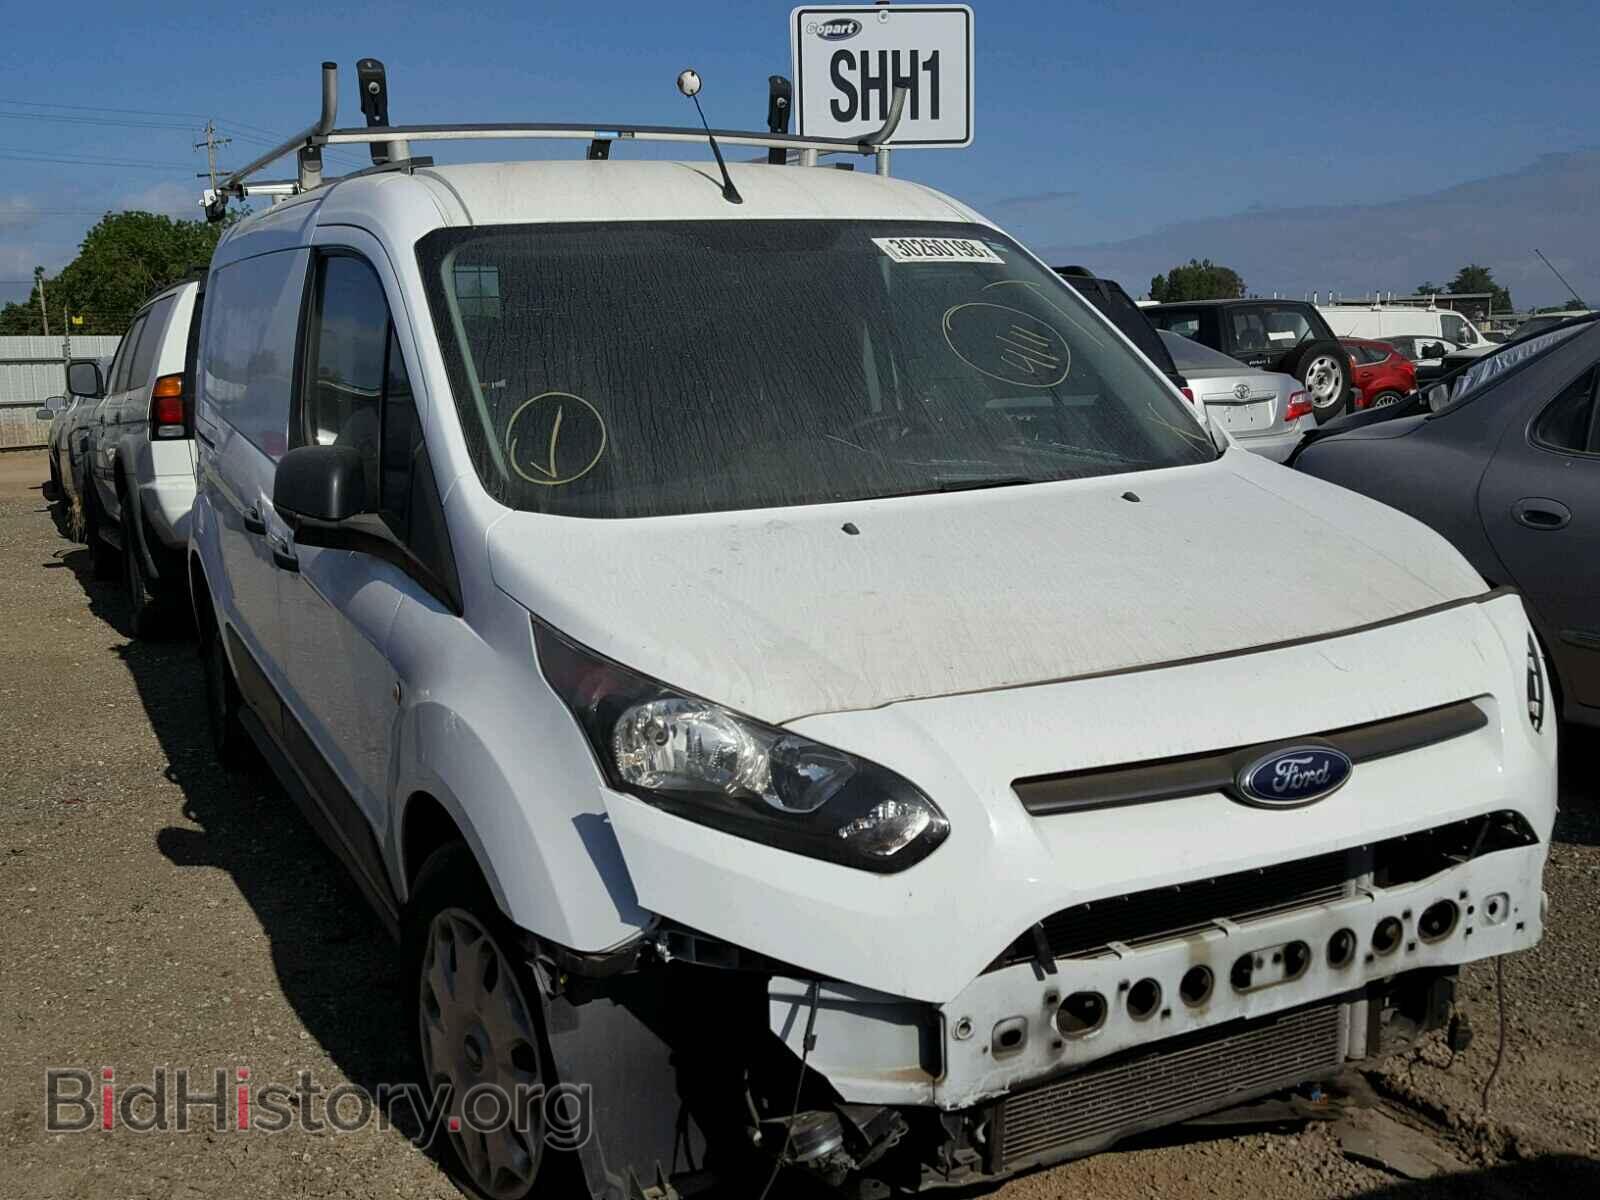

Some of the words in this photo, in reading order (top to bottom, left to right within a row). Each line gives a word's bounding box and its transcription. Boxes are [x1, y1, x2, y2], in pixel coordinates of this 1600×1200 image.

[807, 23, 854, 37] Copart
[829, 49, 940, 122] SHH1
[888, 239, 984, 257] 30260198
[1272, 756, 1330, 792] Ford
